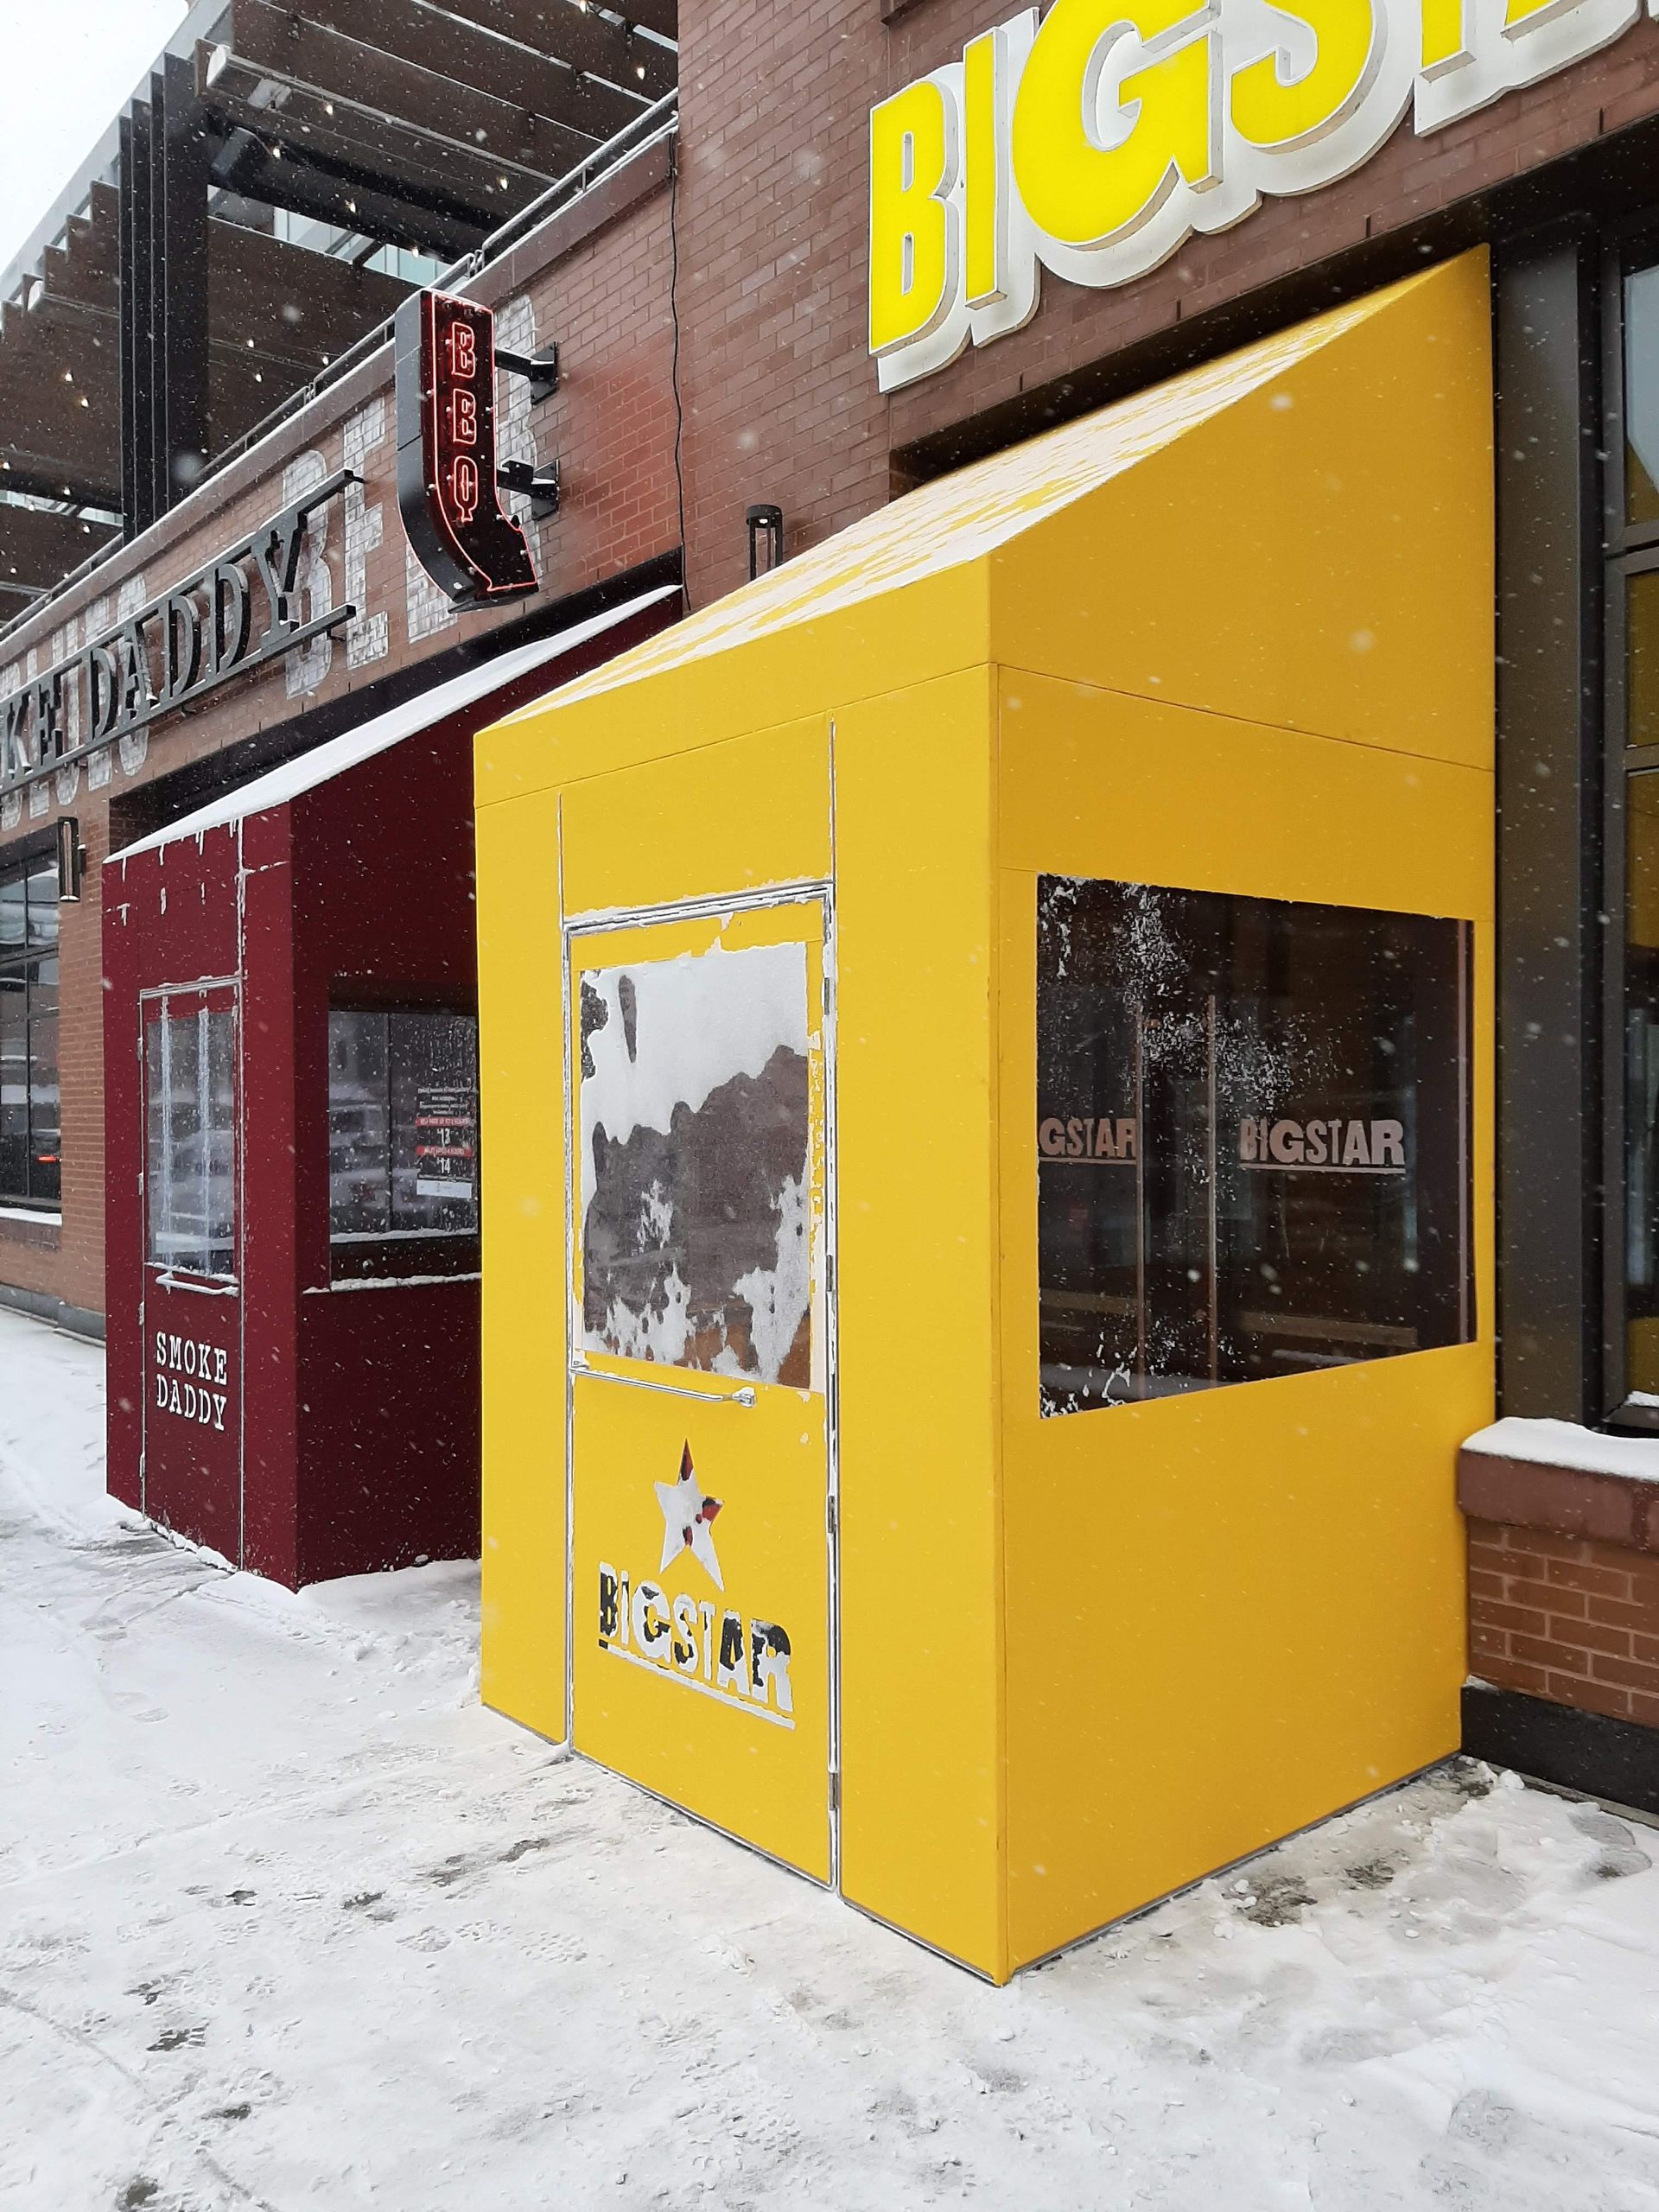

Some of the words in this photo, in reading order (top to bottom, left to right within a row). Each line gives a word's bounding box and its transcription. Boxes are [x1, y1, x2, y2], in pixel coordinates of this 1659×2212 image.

[451, 321, 479, 523] BBQ
[85, 510, 309, 746] DADDY
[1241, 1118, 1405, 1165] BIGSTAR
[156, 1331, 226, 1385] SMOKE
[156, 1373, 227, 1431] DADDY
[599, 1560, 793, 1713] BIGSTAR
